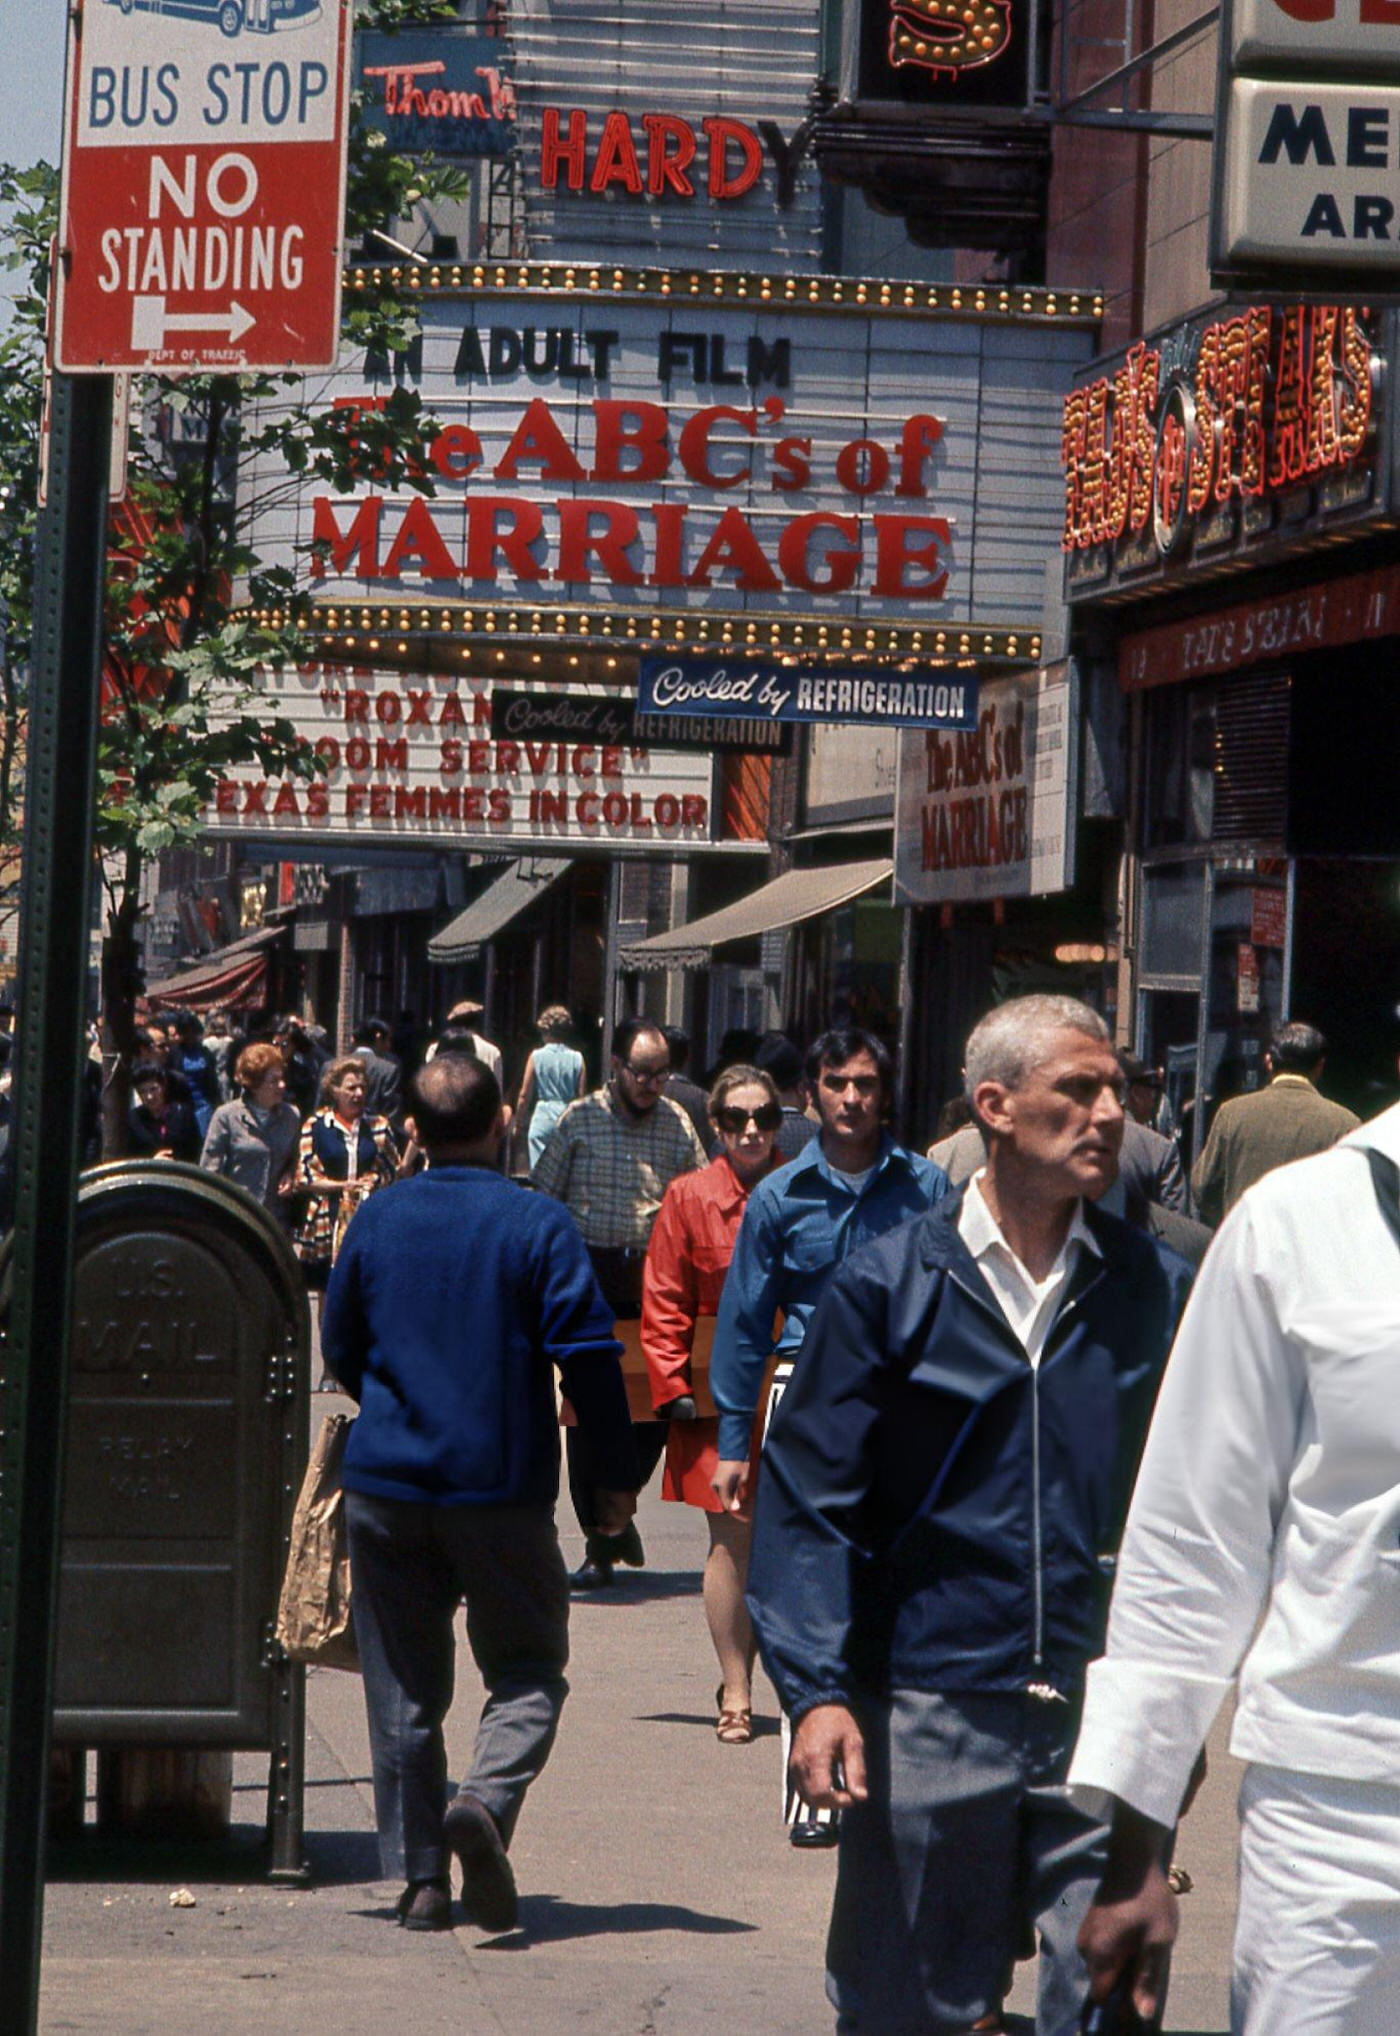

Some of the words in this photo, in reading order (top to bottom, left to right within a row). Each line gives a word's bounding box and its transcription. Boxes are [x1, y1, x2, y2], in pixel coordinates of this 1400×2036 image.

[89, 62, 181, 128] BUS
[203, 60, 329, 126] STOP
[363, 60, 491, 120] Thom
[540, 107, 816, 208] HARDY
[1258, 103, 1400, 168] ME
[148, 152, 258, 220] NO
[1301, 193, 1400, 239] AR
[98, 223, 304, 293] STANDING
[148, 350, 175, 361] DEPT
[180, 350, 195, 361] OF
[453, 325, 619, 379] ADULT
[657, 330, 791, 388] FILM
[493, 396, 812, 491] ABC's
[836, 414, 943, 498] of
[309, 496, 952, 600] MARRIAGE
[503, 698, 598, 734] Cooled
[597, 708, 628, 744] by
[631, 710, 783, 747] REFRIGERATION
[652, 666, 759, 707] Cooled
[757, 675, 792, 717] by
[797, 677, 966, 719] REFRIGERATION
[199, 780, 330, 817] EXAS
[345, 783, 511, 822] FEMMES
[529, 788, 568, 825] IN
[575, 790, 709, 827] COLOR
[921, 786, 1028, 873] MARRIAGE
